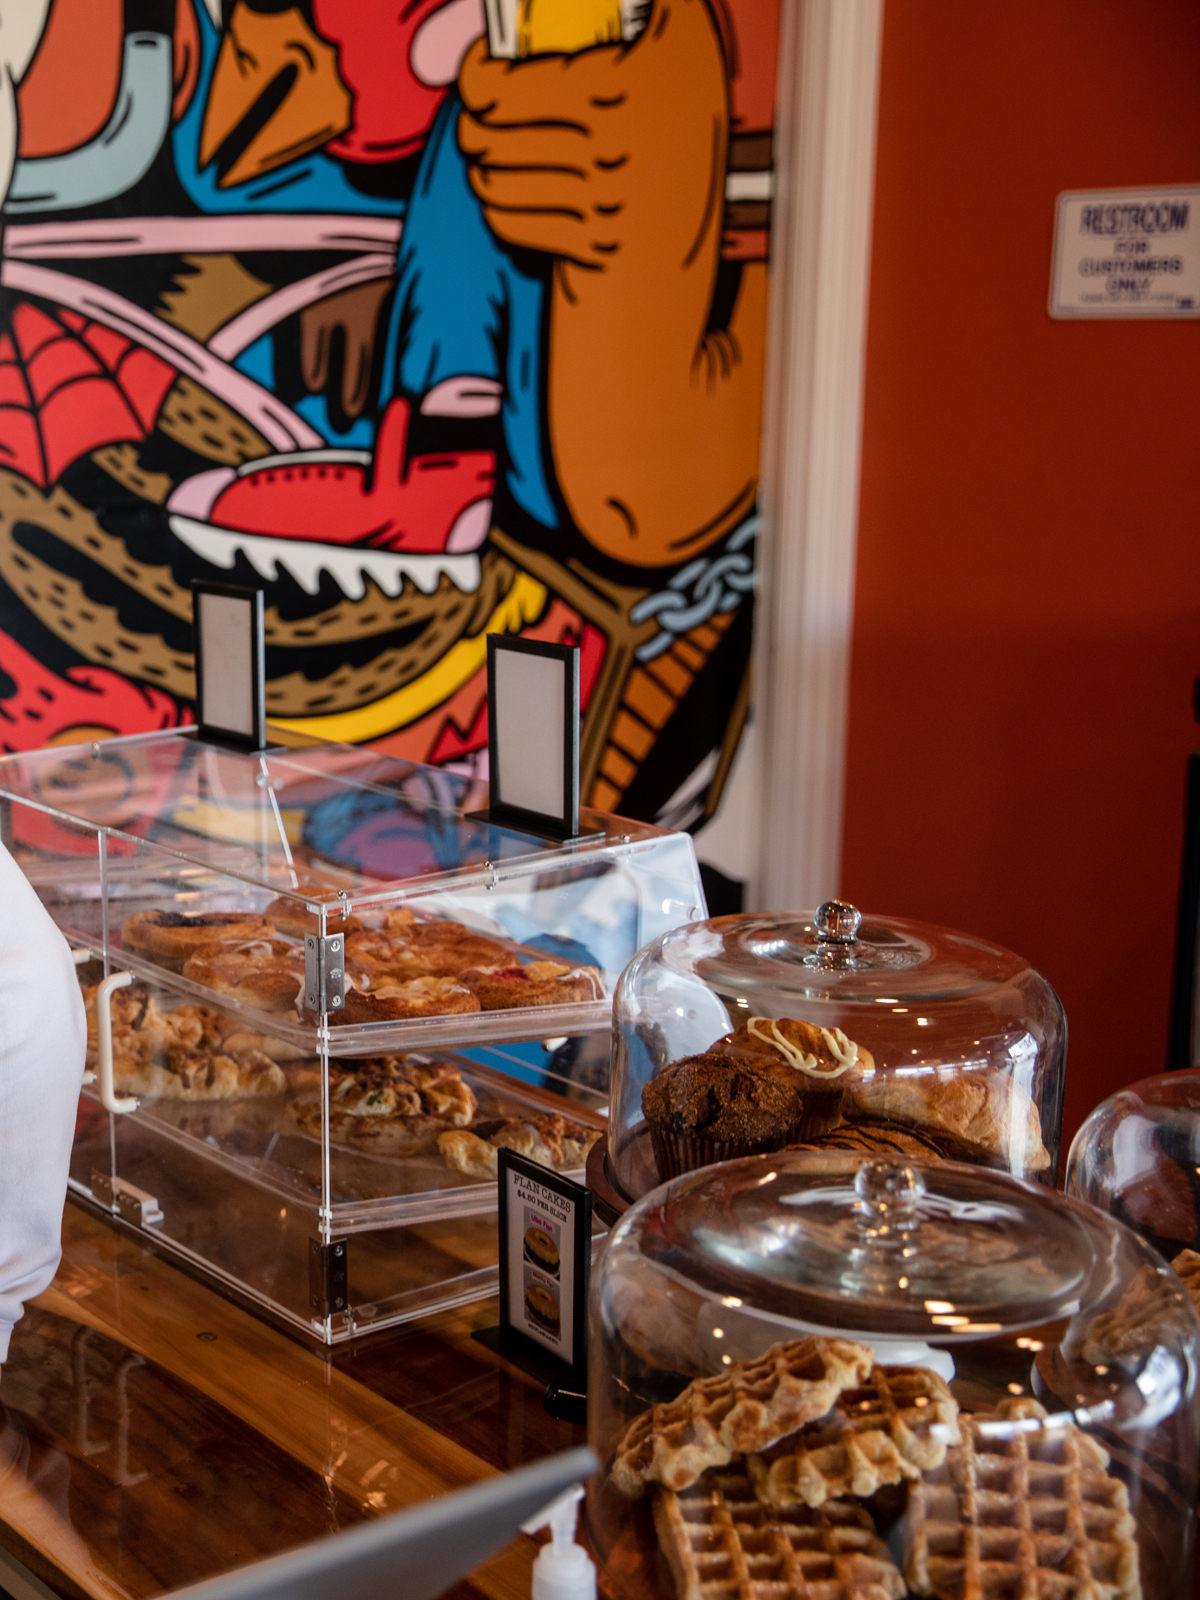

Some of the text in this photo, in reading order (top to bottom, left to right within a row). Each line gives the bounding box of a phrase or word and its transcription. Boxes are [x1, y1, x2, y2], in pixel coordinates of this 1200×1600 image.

[1080, 202, 1190, 235] RESTROOM
[1079, 256, 1183, 277] CUSTOMERS
[513, 1174, 571, 1213] FLAN CAKES
[517, 1189, 567, 1223] $4.50 PER SLICE
